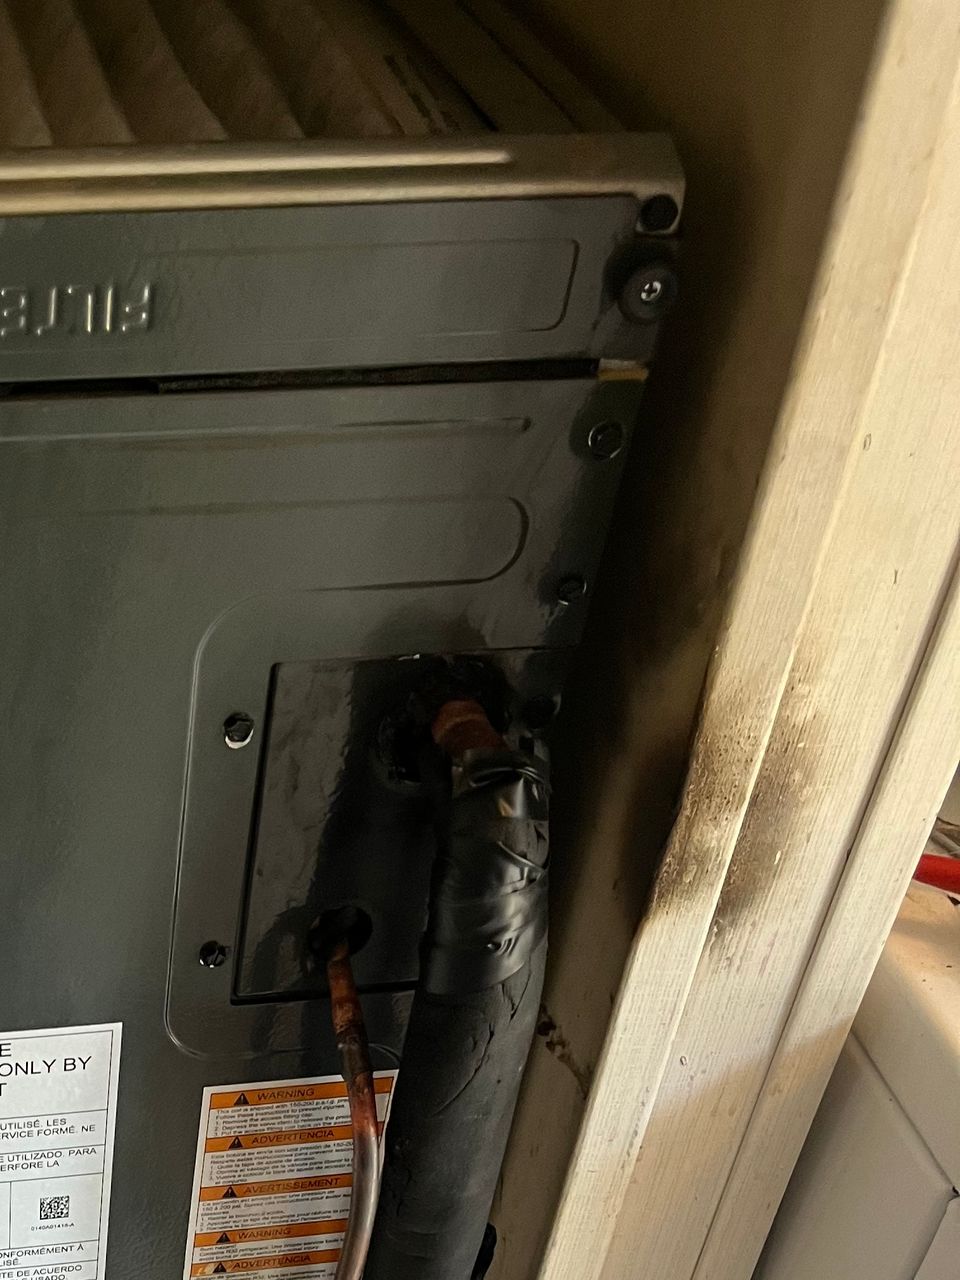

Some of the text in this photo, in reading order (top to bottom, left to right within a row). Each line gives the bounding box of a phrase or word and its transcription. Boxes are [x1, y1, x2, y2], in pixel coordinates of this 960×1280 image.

[63, 1055, 92, 1071] BY
[256, 1087, 315, 1101] WARNING
[46, 1117, 66, 1127] LES
[81, 1124, 95, 1133] NE
[251, 1129, 335, 1144] ADVERTENCIA
[68, 1146, 96, 1156] PARA
[243, 1178, 340, 1194] AVERTISSEMENT
[238, 1227, 291, 1238] WARNING
[232, 1255, 311, 1270] ADVERTENCIA
